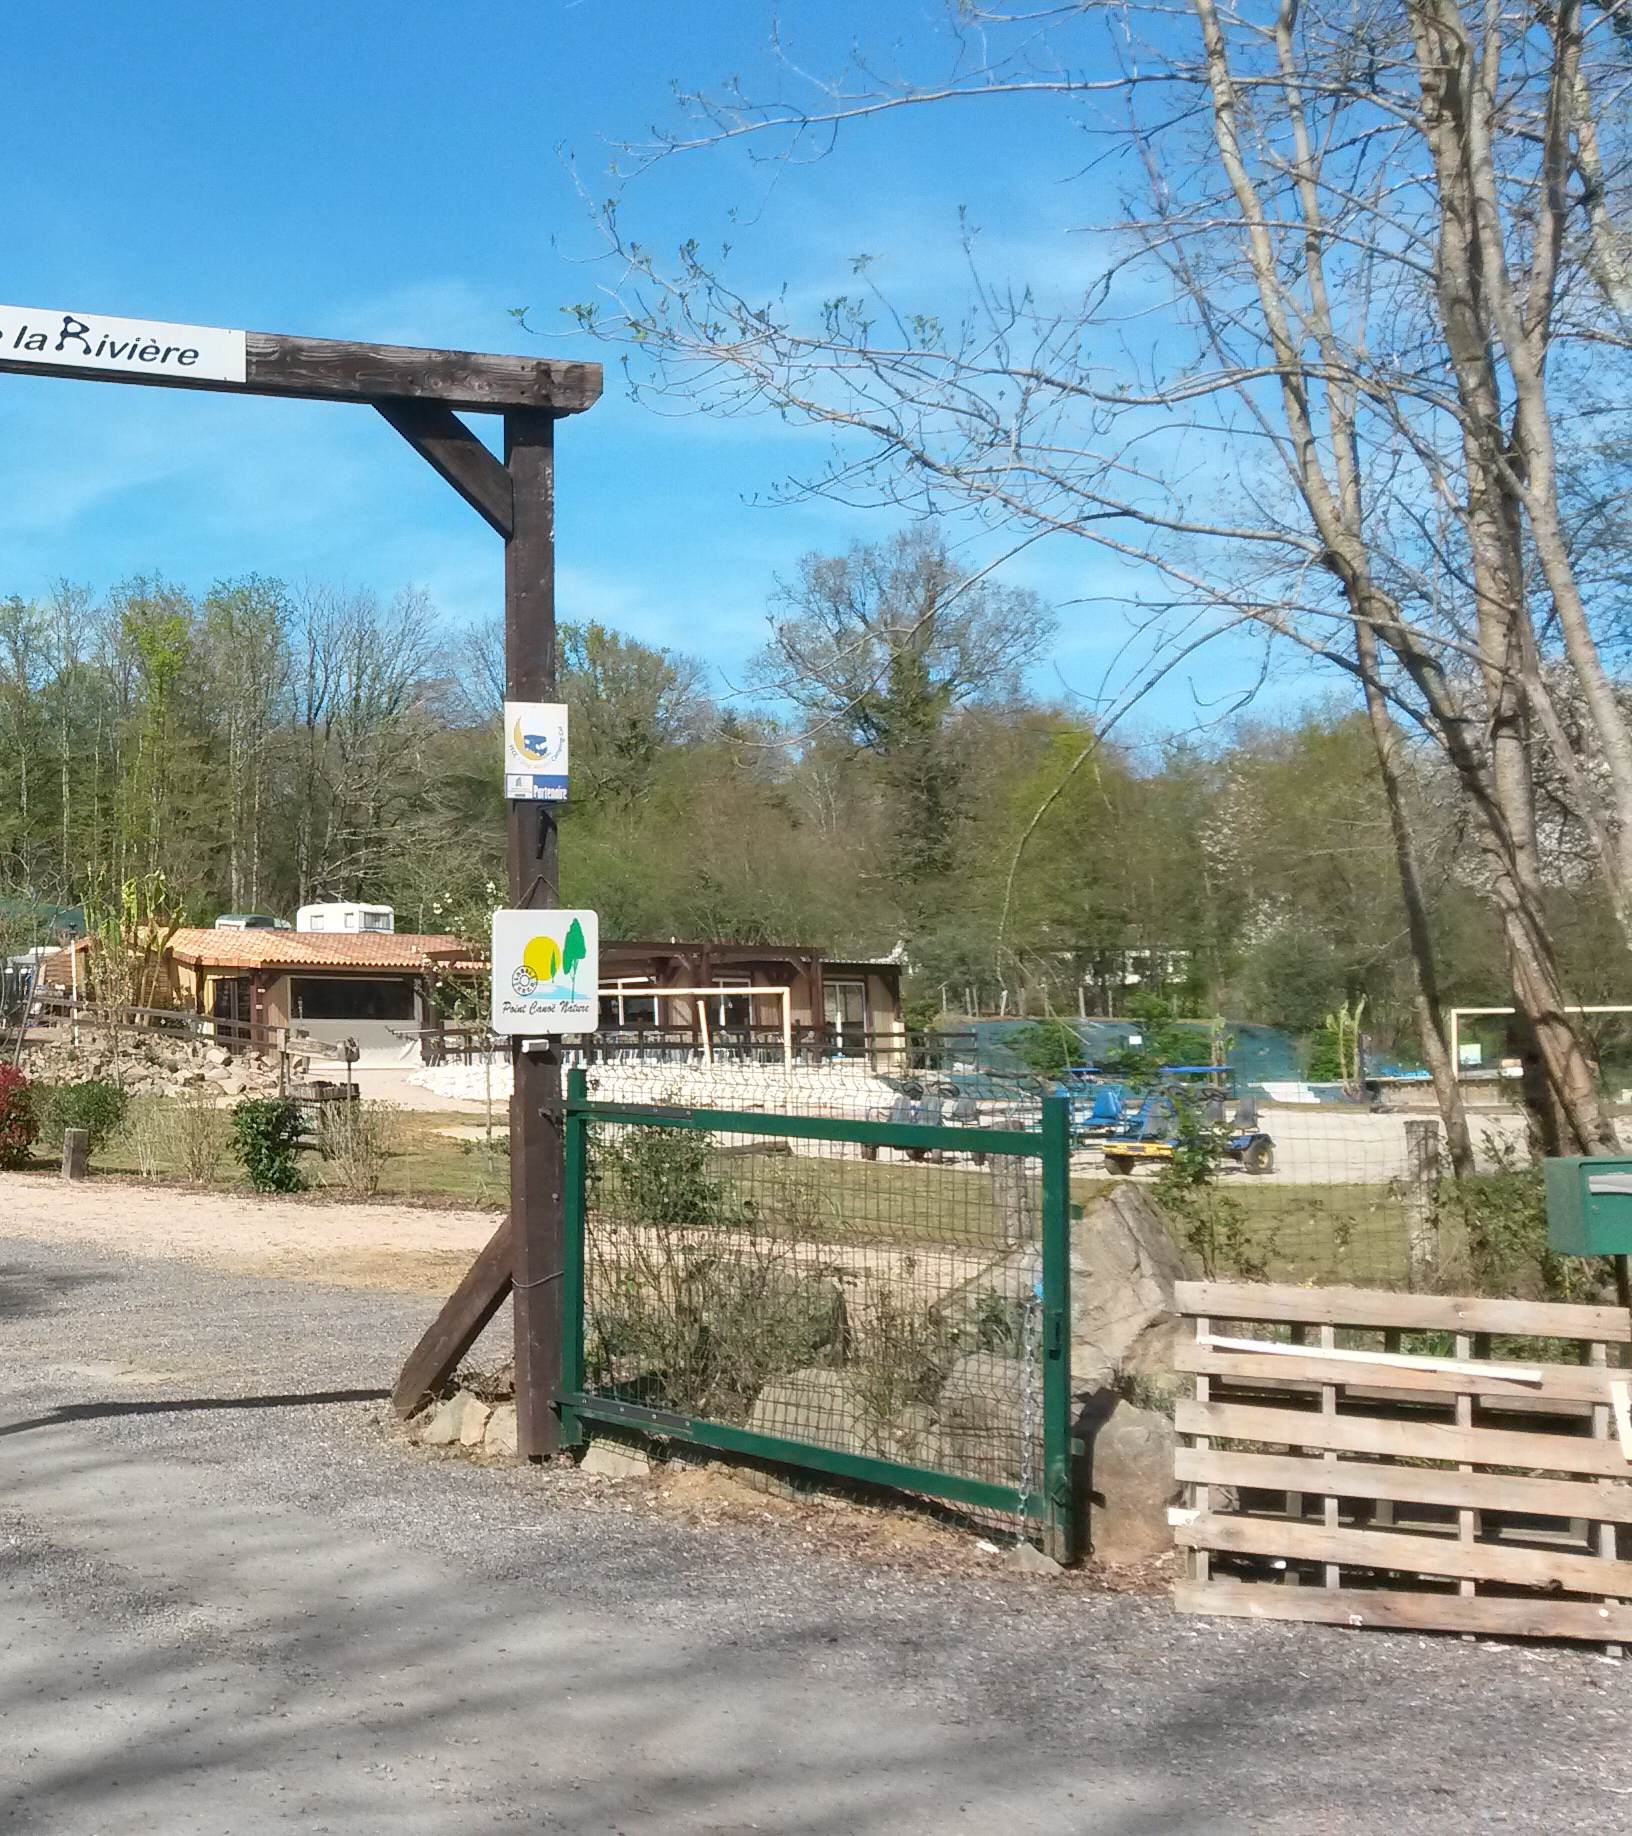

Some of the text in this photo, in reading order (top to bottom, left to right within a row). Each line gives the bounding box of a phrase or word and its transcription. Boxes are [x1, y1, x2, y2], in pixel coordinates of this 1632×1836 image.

[13, 325, 49, 351] la
[55, 315, 200, 367] Rivière
[502, 1001, 527, 1014] Point
[559, 1000, 590, 1013] Nature
